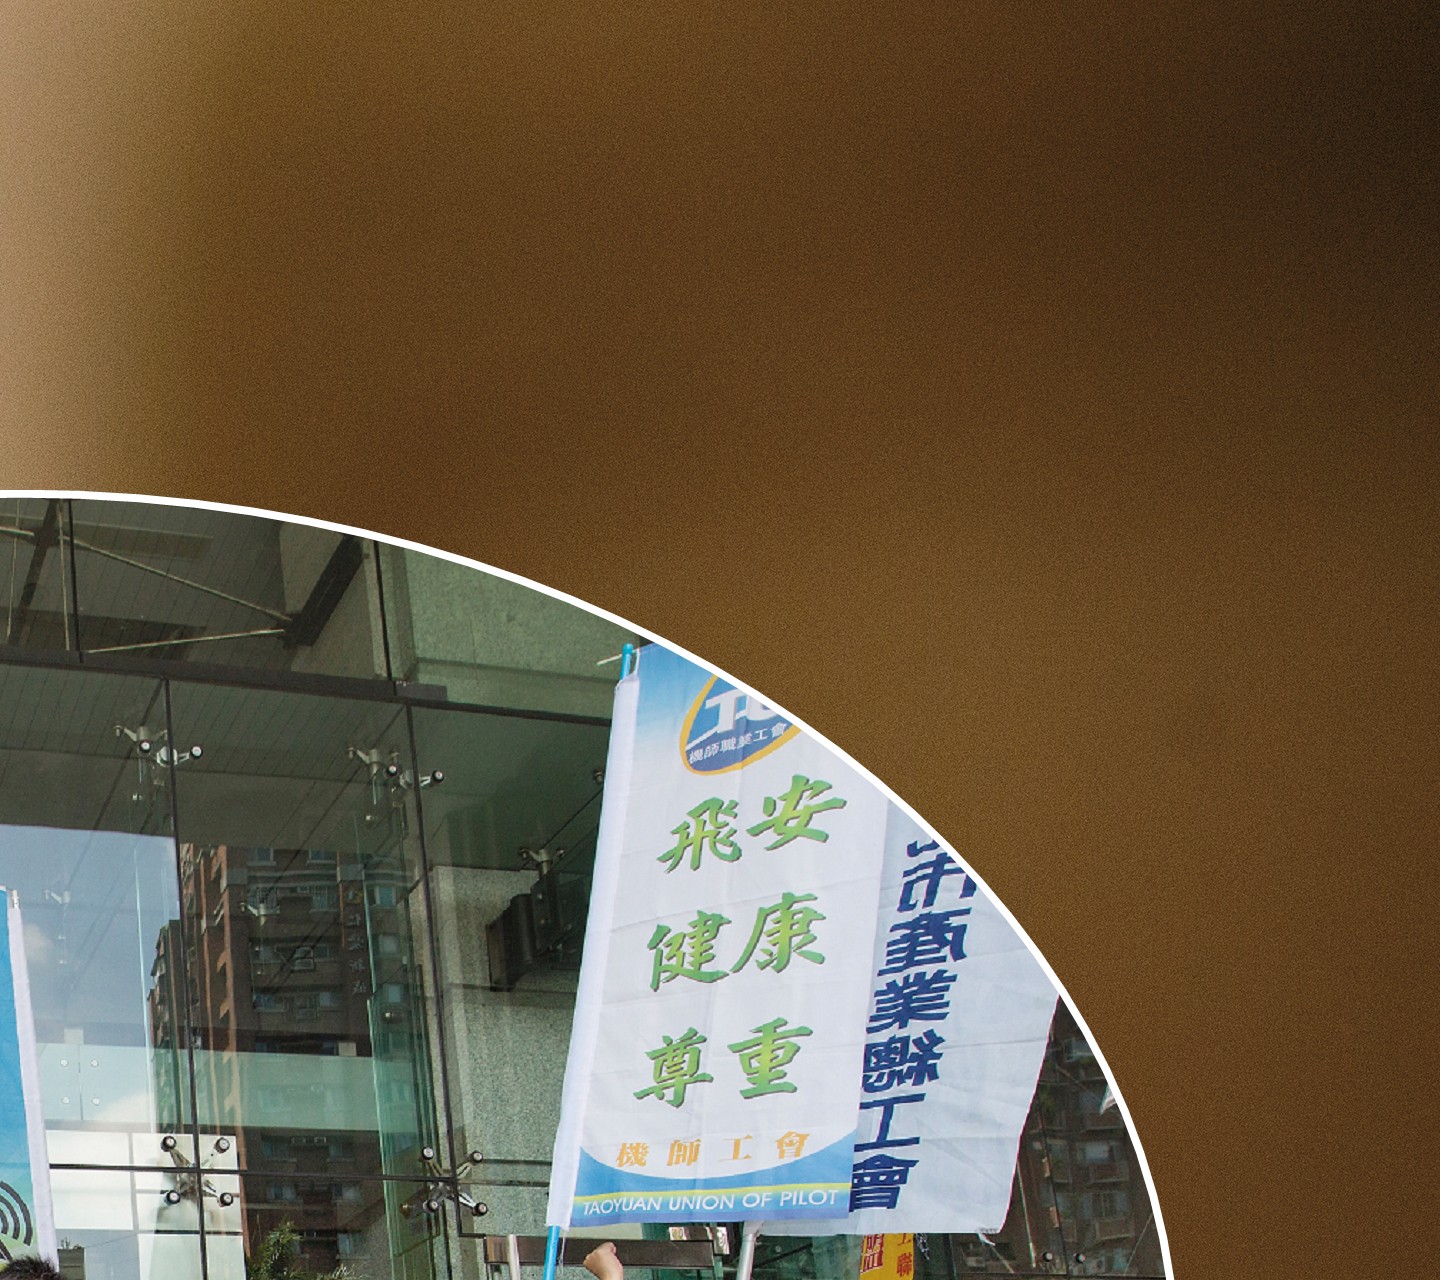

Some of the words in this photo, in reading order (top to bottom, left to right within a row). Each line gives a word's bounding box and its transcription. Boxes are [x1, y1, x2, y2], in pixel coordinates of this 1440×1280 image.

[655, 774, 846, 873] 飛安
[647, 891, 827, 992] 健康
[632, 1016, 814, 1108] 尊重
[616, 1130, 811, 1168] 機師工會
[582, 1194, 662, 1217] TAOYUAN
[667, 1192, 734, 1212] UNION
[742, 1190, 774, 1211] OF
[780, 1188, 840, 1209] PILOT
